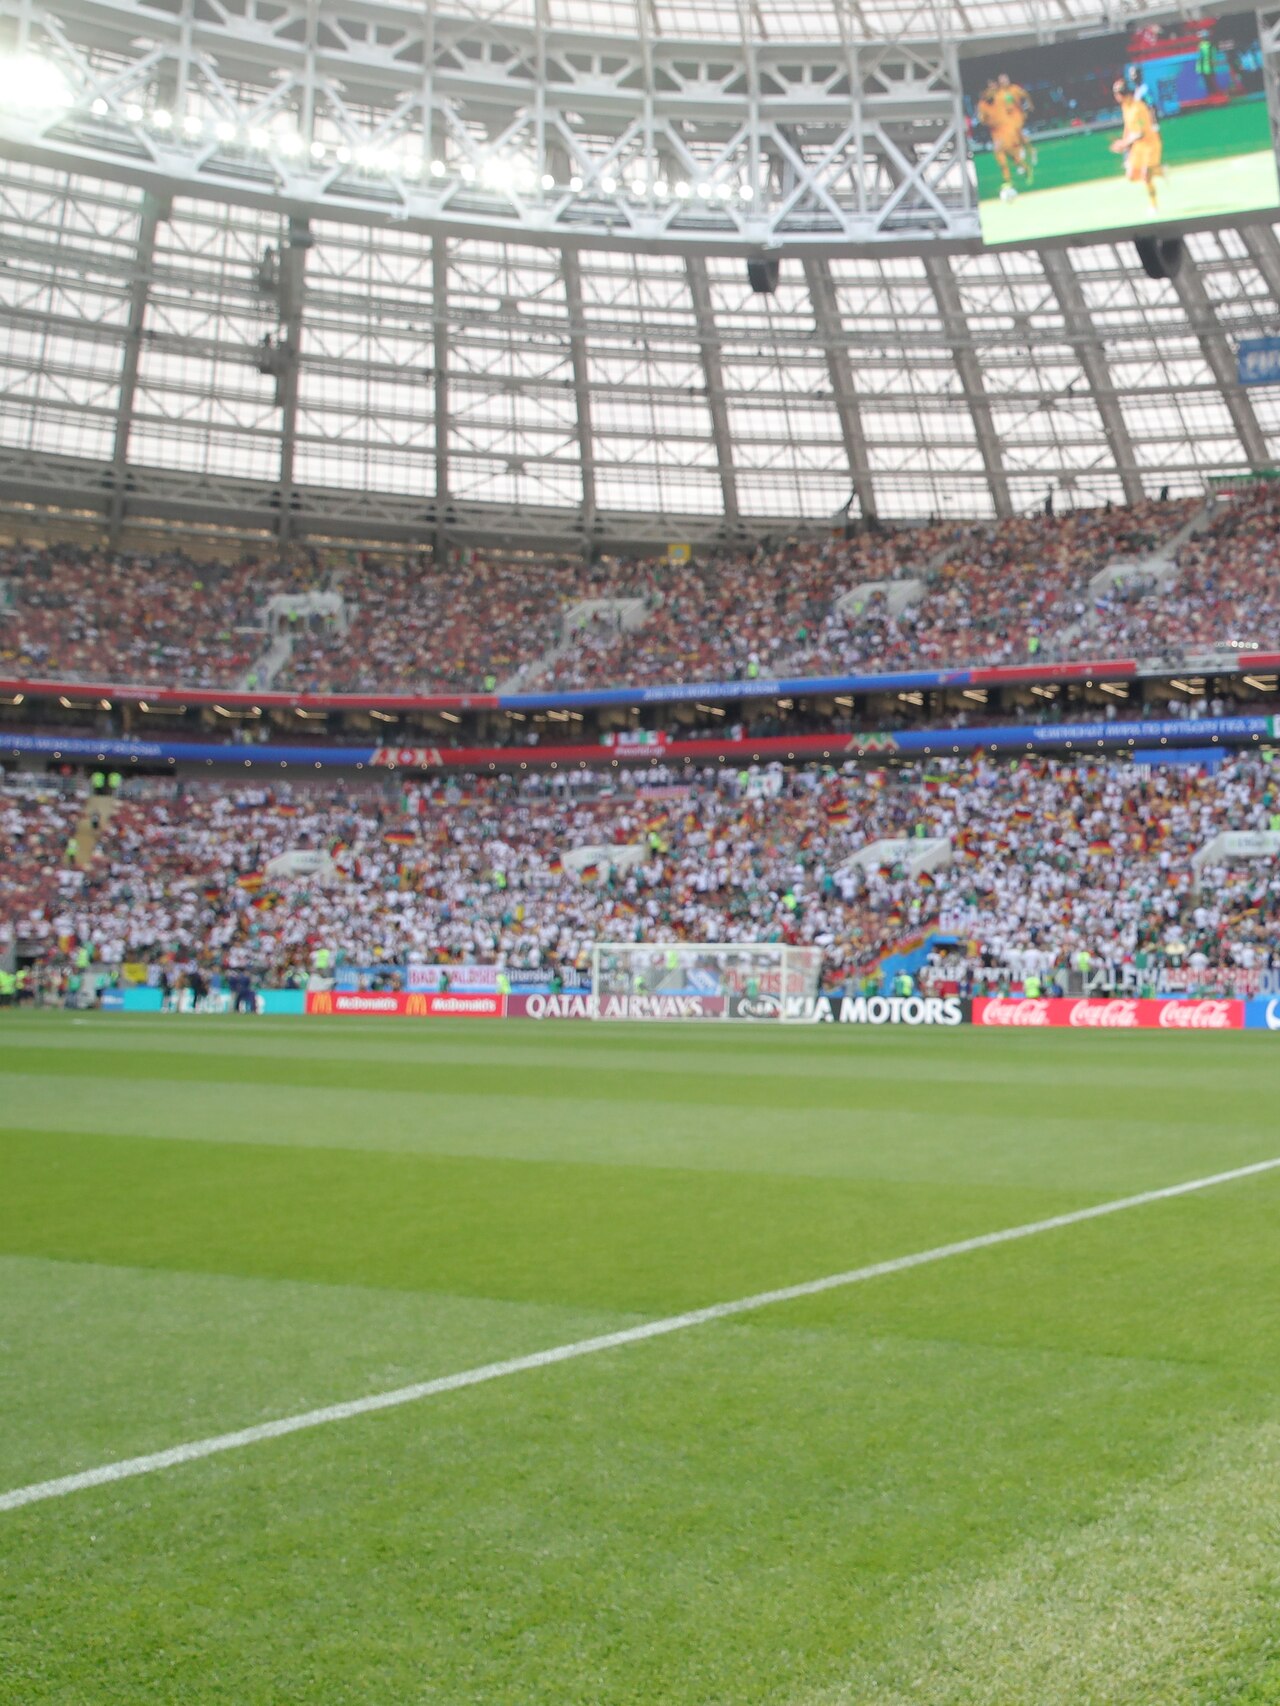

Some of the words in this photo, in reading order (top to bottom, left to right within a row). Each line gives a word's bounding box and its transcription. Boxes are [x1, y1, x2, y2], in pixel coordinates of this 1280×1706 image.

[336, 996, 398, 1012] McDonald's
[431, 997, 496, 1012] McDonald's
[526, 994, 598, 1019] QATAR
[605, 995, 703, 1018] AIRWAYS
[839, 997, 962, 1024] MOTORS
[982, 1000, 1049, 1026] Coca-Cola
[1069, 1000, 1138, 1026] Coca-Cola
[1159, 1000, 1231, 1027] Coca-Cola
